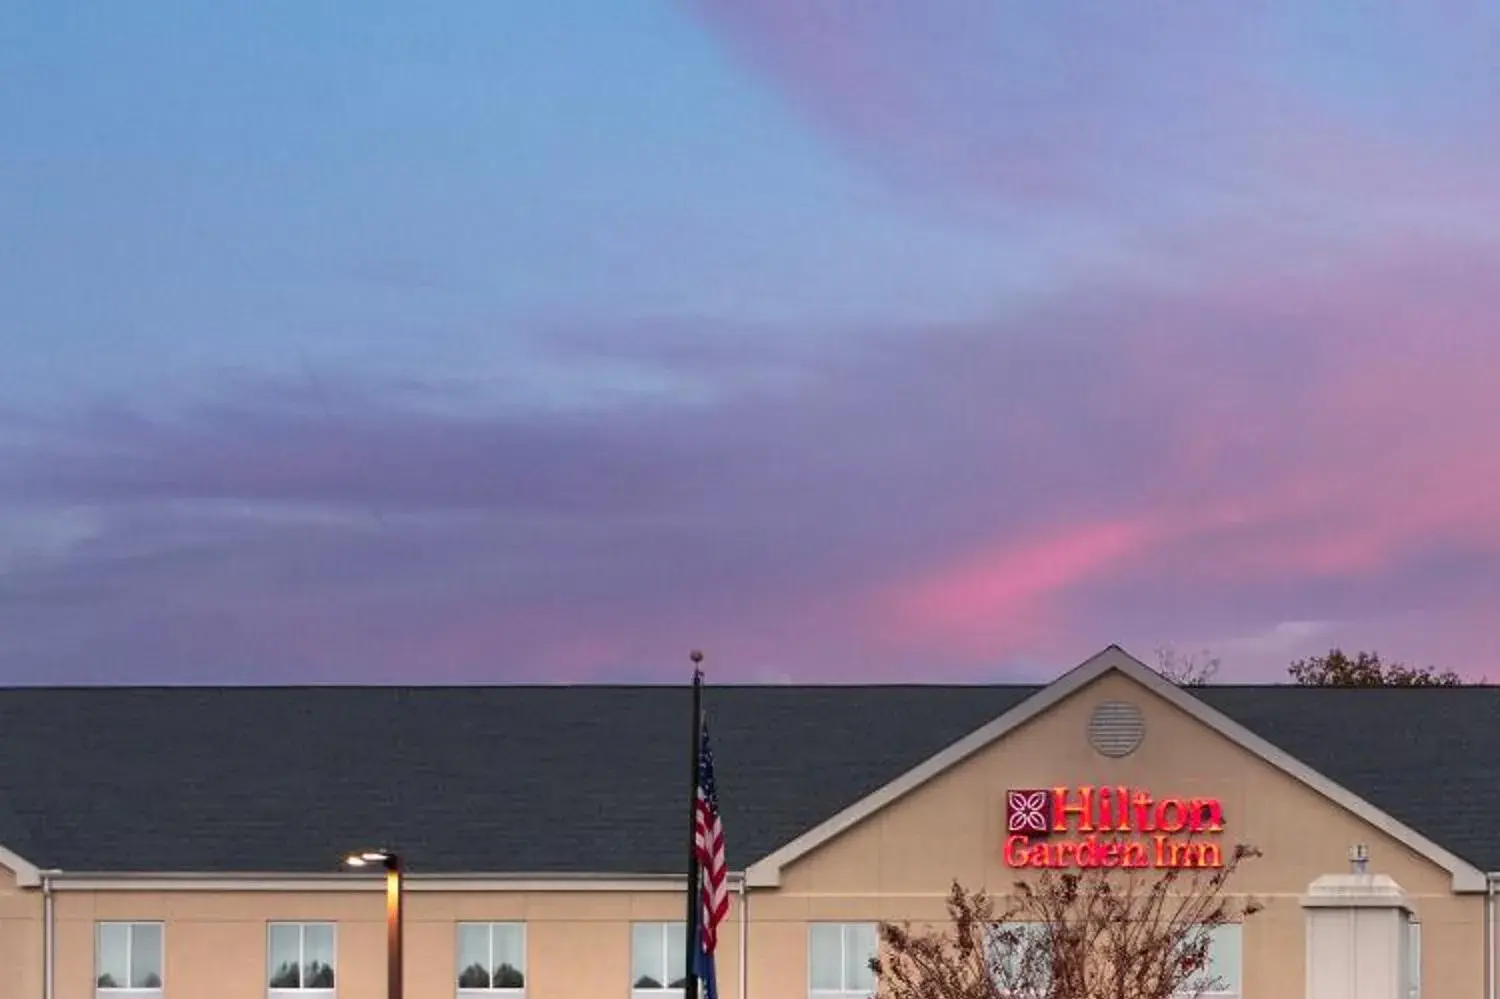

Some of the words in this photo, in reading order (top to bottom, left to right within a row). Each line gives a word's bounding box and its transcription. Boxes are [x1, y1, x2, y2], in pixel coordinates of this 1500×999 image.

[1051, 786, 1224, 832] Hilton
[1003, 833, 1149, 869] Garden
[1152, 834, 1224, 869] Inn
